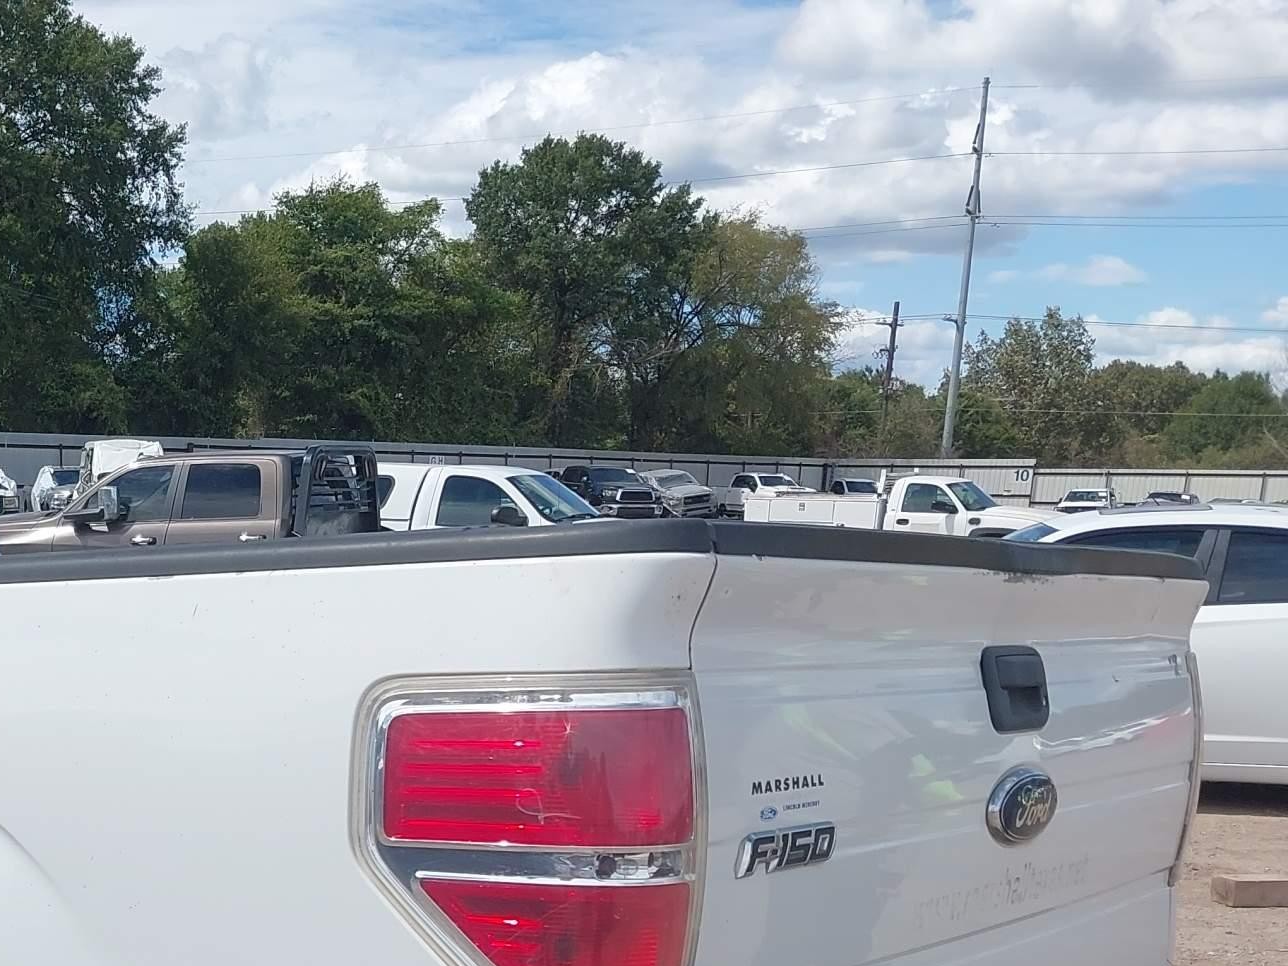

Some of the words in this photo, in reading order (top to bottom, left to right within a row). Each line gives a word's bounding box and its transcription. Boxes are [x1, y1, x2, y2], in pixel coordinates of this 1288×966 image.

[1014, 469, 1030, 482] 10
[751, 773, 824, 796] MARSHALL
[1015, 785, 1053, 828] Ford
[739, 824, 836, 876] F-150
